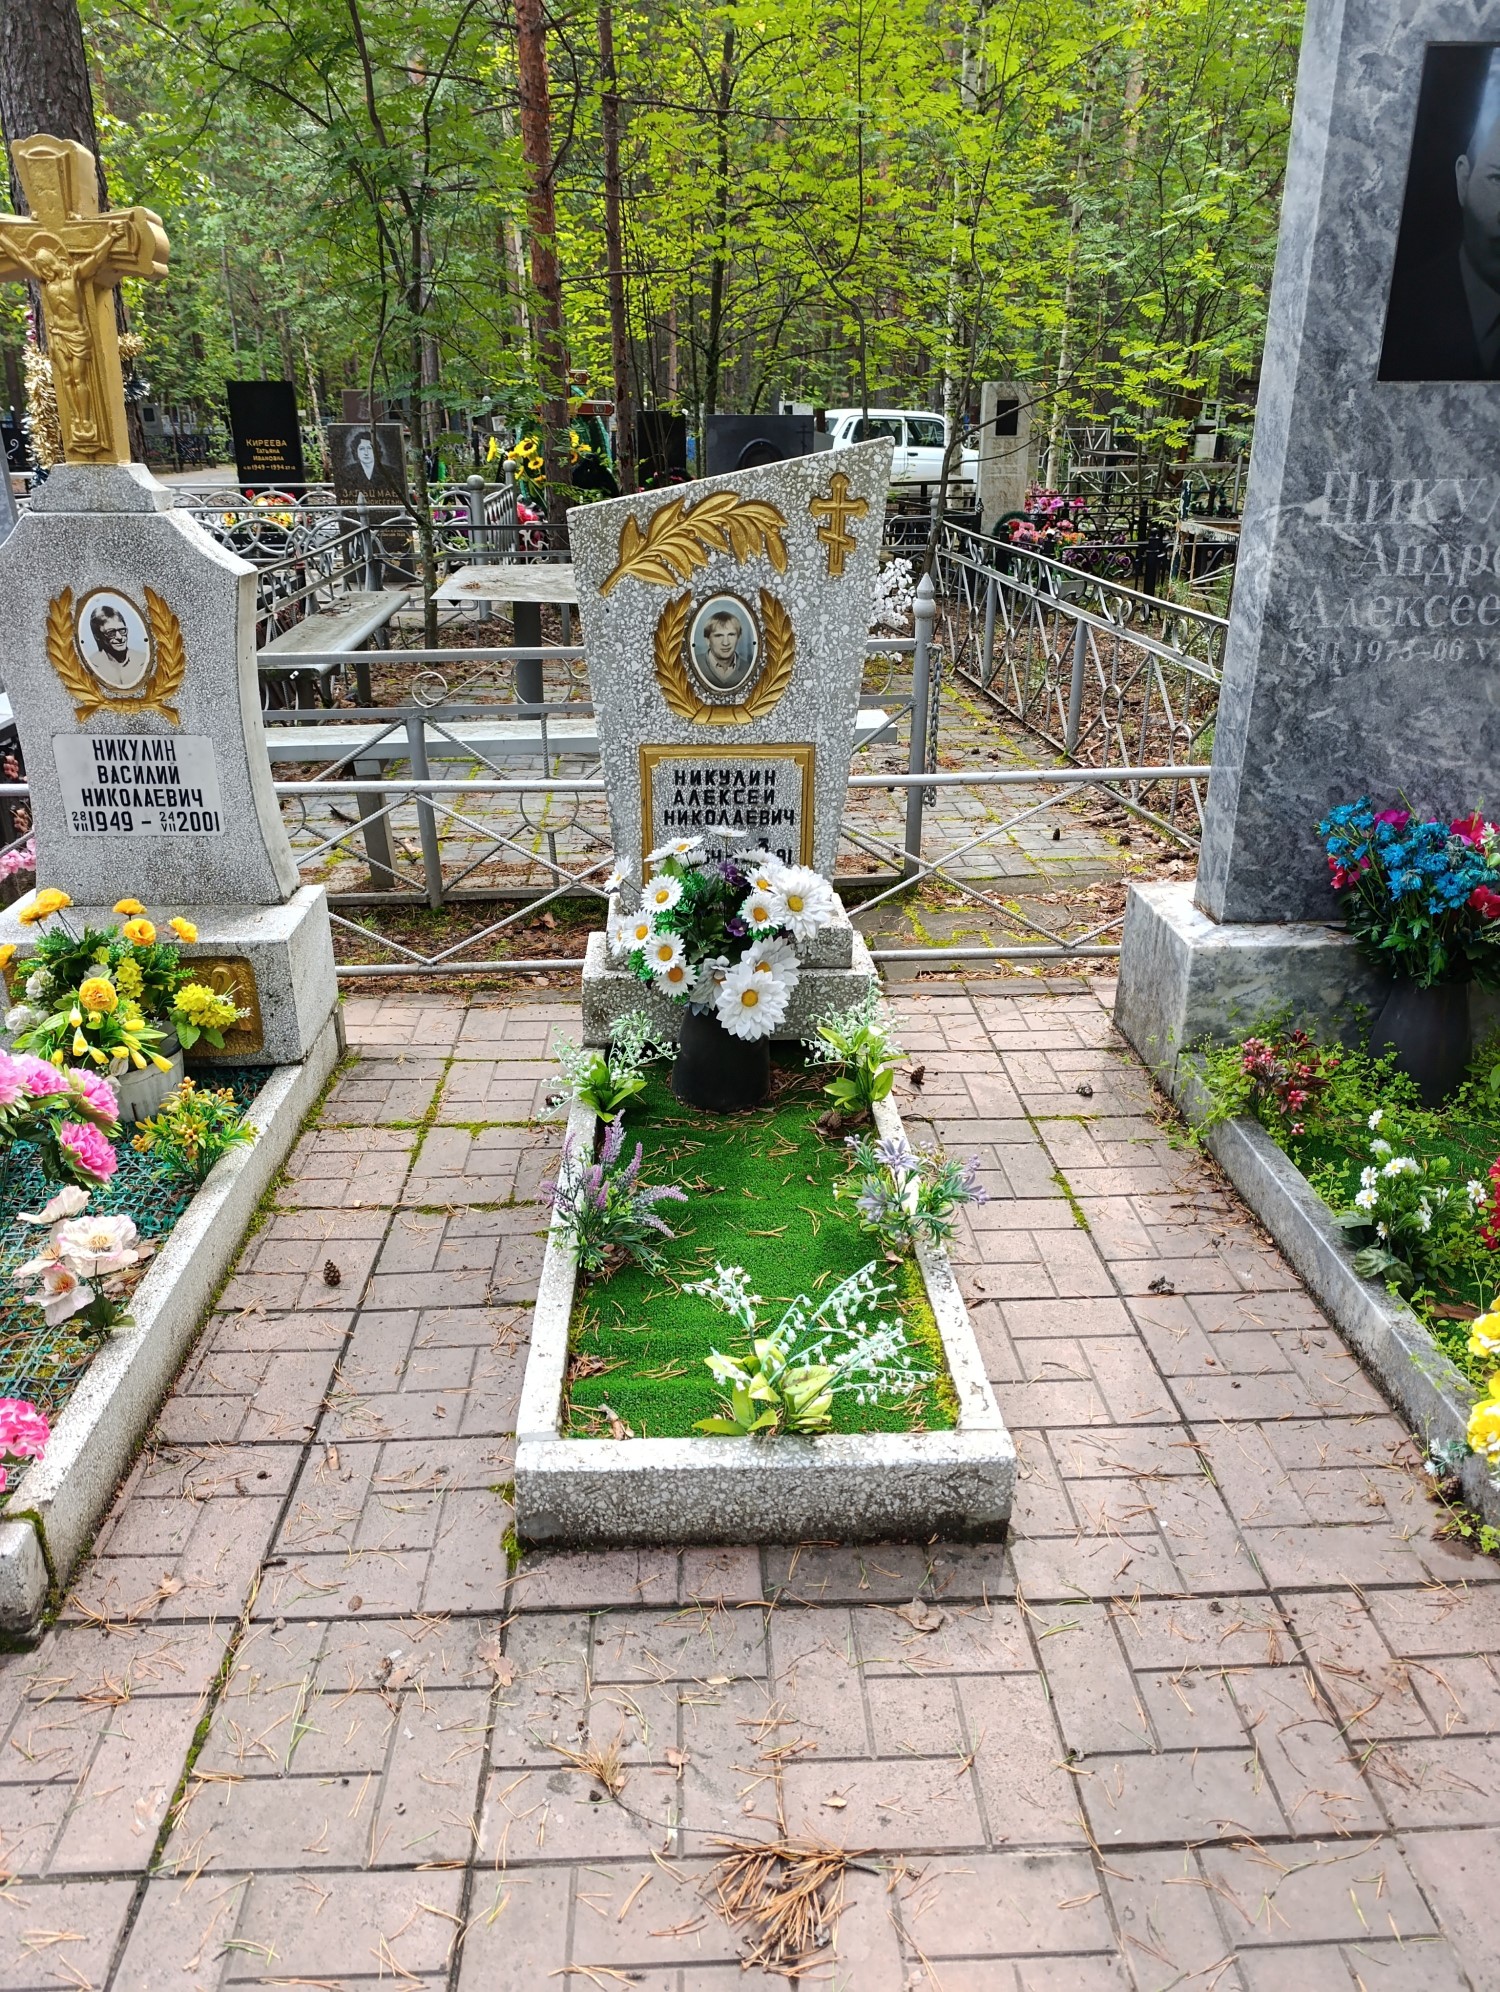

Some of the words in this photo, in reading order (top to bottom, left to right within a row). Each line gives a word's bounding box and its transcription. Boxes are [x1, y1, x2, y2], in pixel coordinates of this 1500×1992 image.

[245, 438, 288, 447] КИРЕЕВА
[92, 739, 177, 762] НИКУЛИН
[674, 769, 776, 787] НИКУЛИН
[81, 788, 204, 808] НИКОЛАЕВИЧ
[71, 811, 87, 821] 28
[88, 811, 134, 832] 1949
[159, 811, 175, 822] 24
[177, 811, 221, 832] 2001
[663, 809, 795, 826] НИКОЛАЕВИЧ
